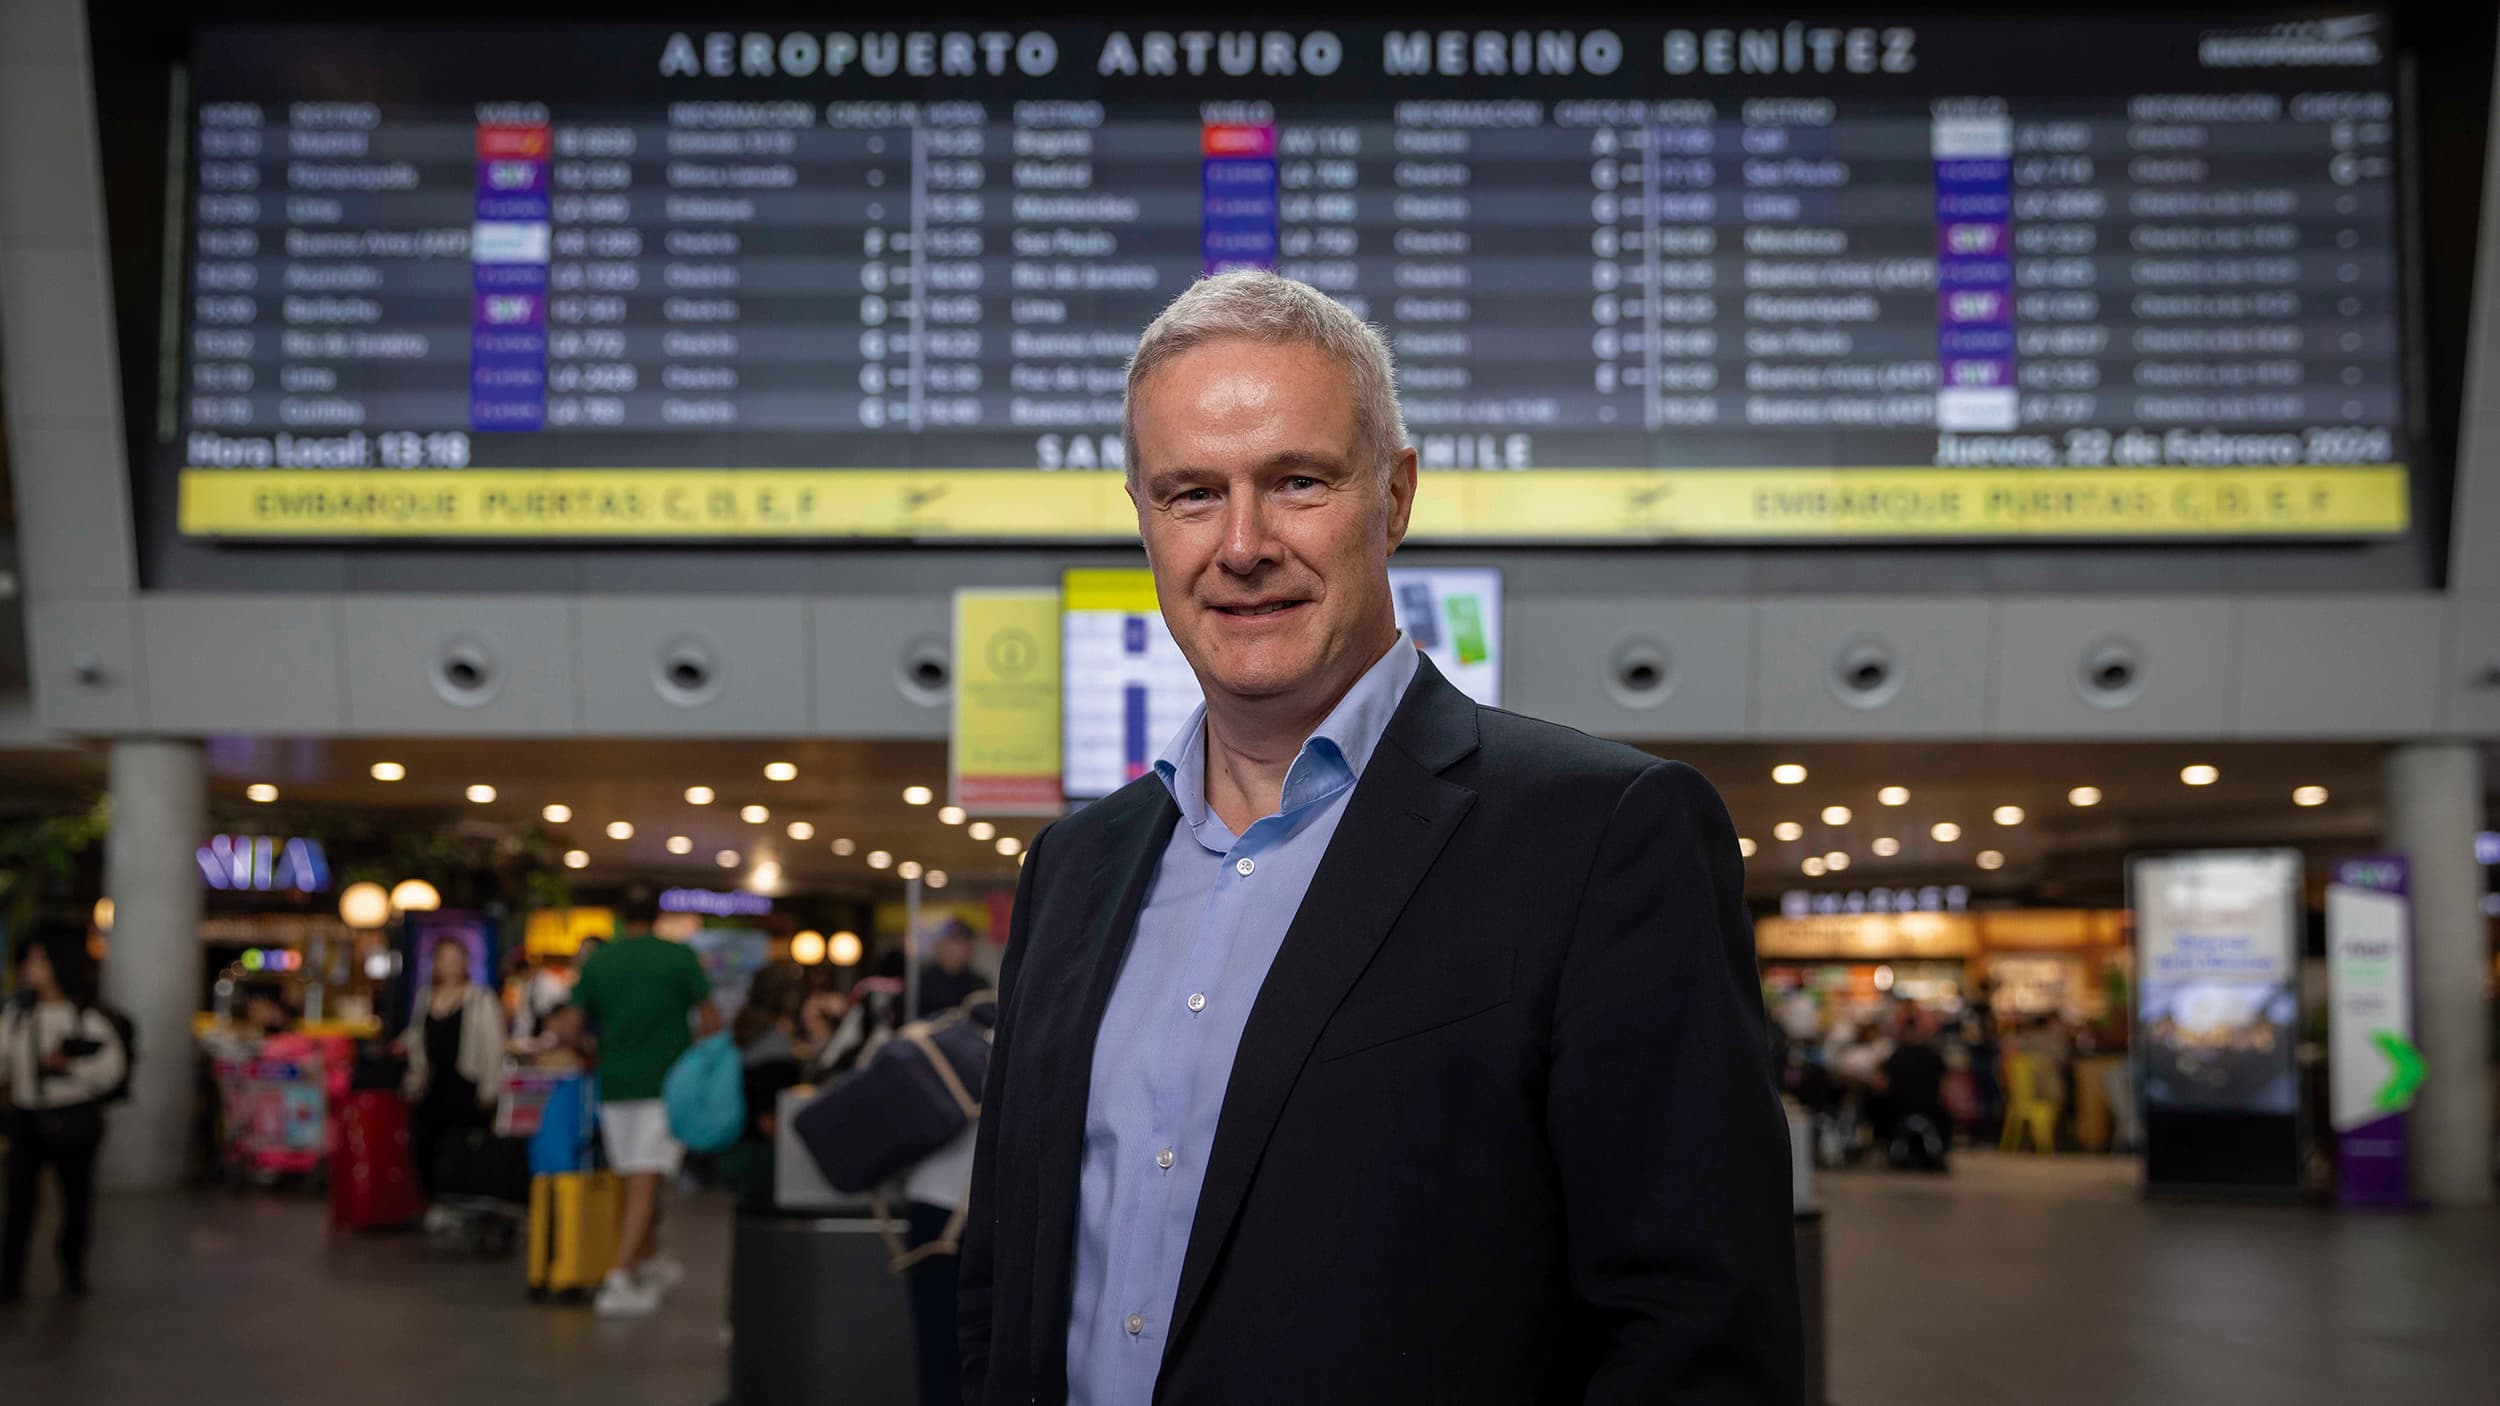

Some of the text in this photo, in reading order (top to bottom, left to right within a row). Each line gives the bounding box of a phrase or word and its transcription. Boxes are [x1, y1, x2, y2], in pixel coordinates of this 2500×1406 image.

[660, 21, 1917, 77] AEROPUERTO ARTURO MERINO BENÍTEZ
[186, 432, 273, 469] Hora
[2062, 429, 2110, 466] 22
[2113, 429, 2161, 465] de
[2164, 427, 2302, 465] Febrero
[252, 487, 458, 522] EMBARQUE
[1749, 485, 1960, 520] EMBARQUE
